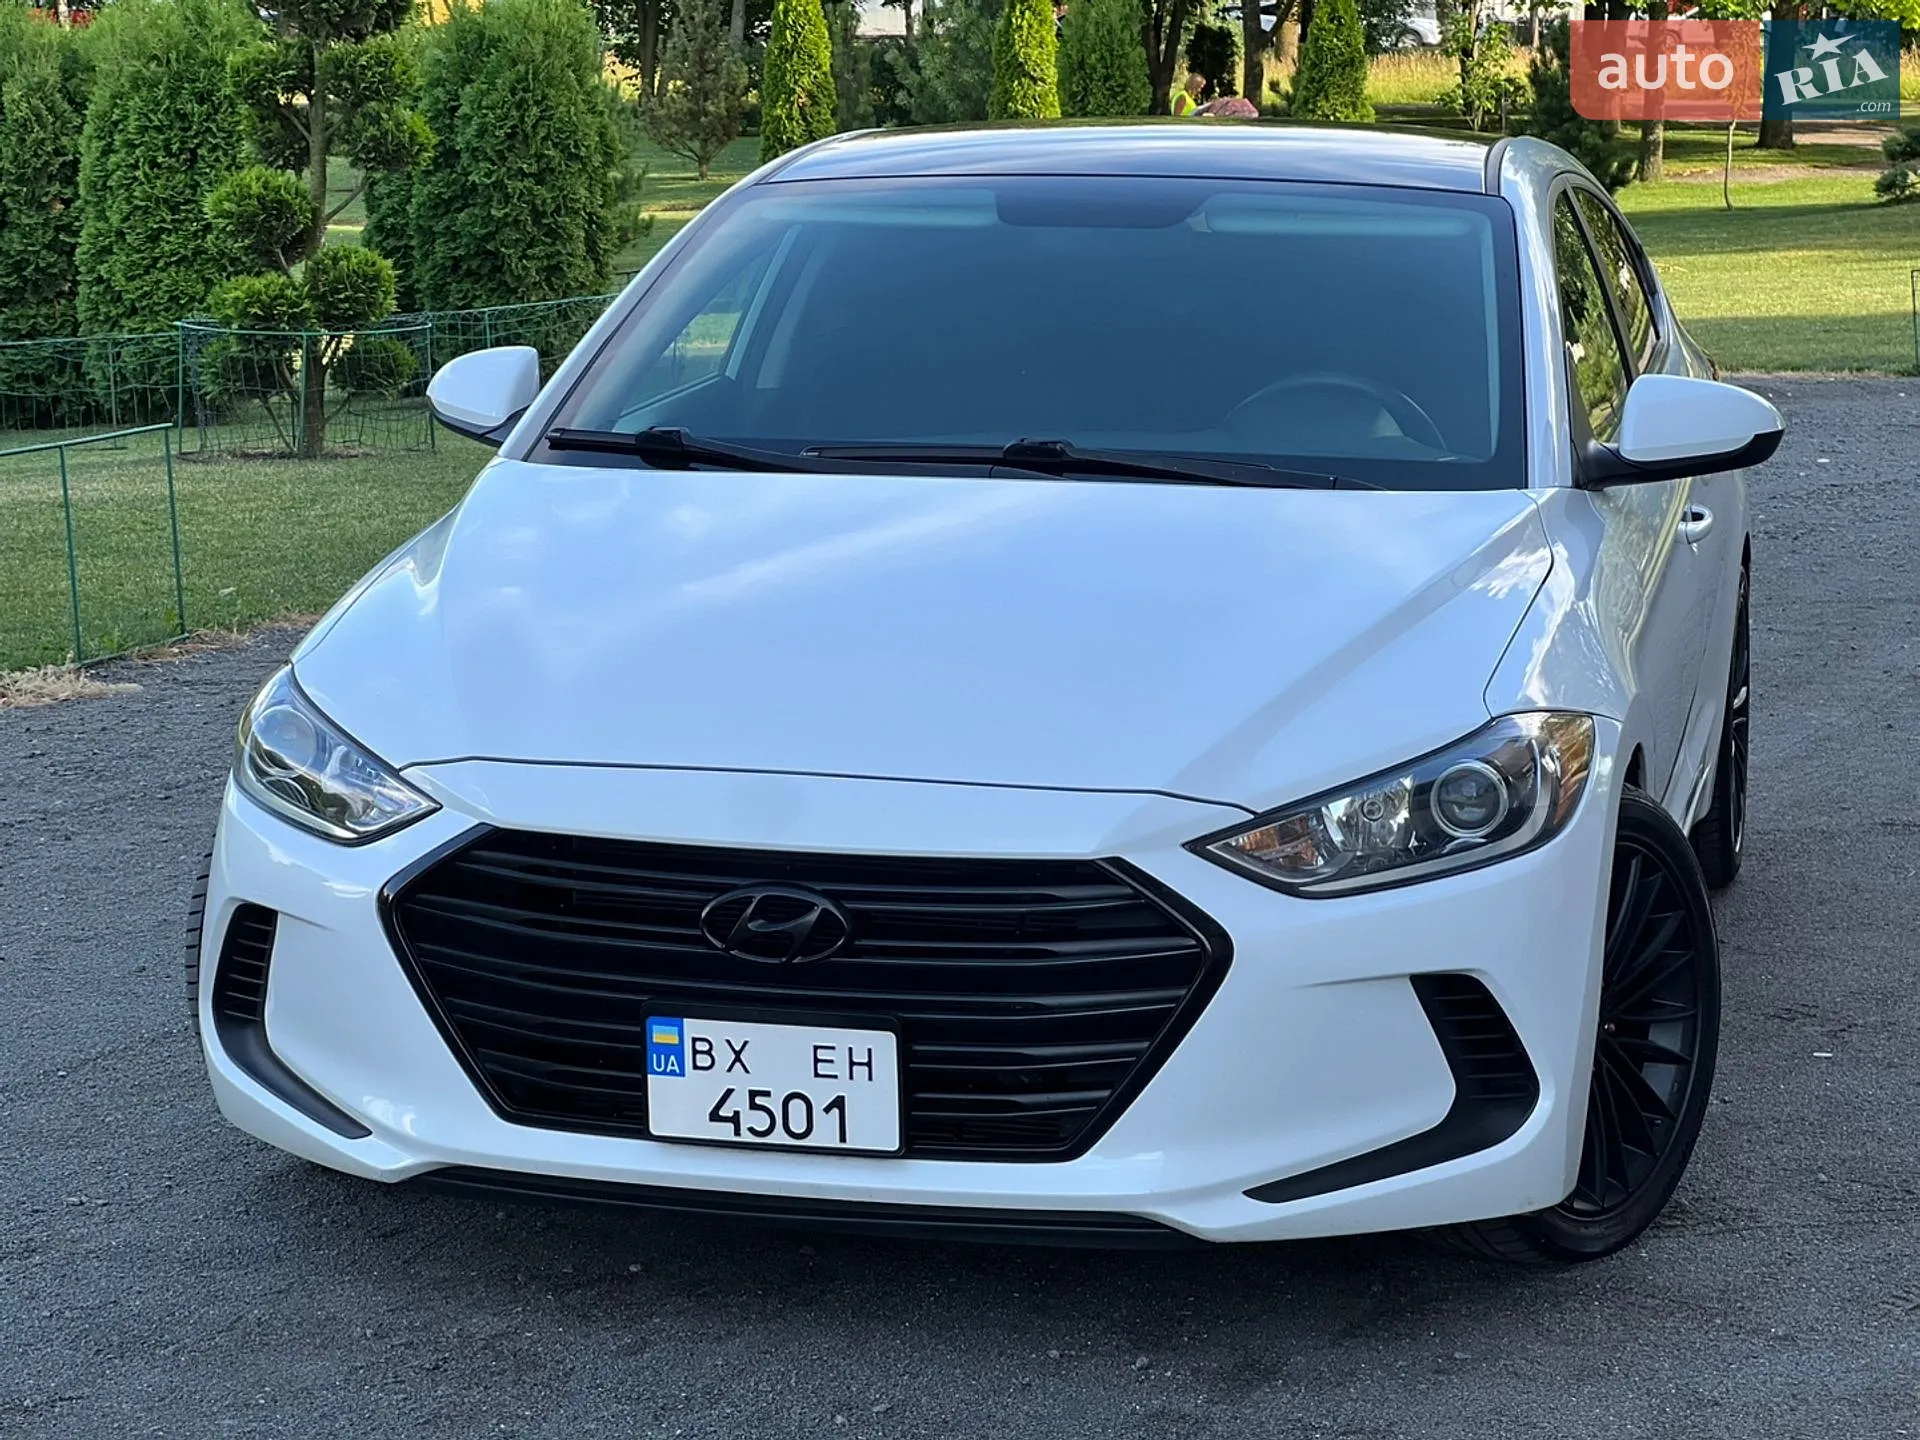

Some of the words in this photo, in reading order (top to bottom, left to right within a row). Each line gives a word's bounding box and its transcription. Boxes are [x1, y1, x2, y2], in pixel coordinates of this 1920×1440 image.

[652, 1054, 680, 1074] UA
[690, 1036, 751, 1074] BX
[812, 1044, 874, 1082] EH
[708, 1087, 848, 1144] 4501
